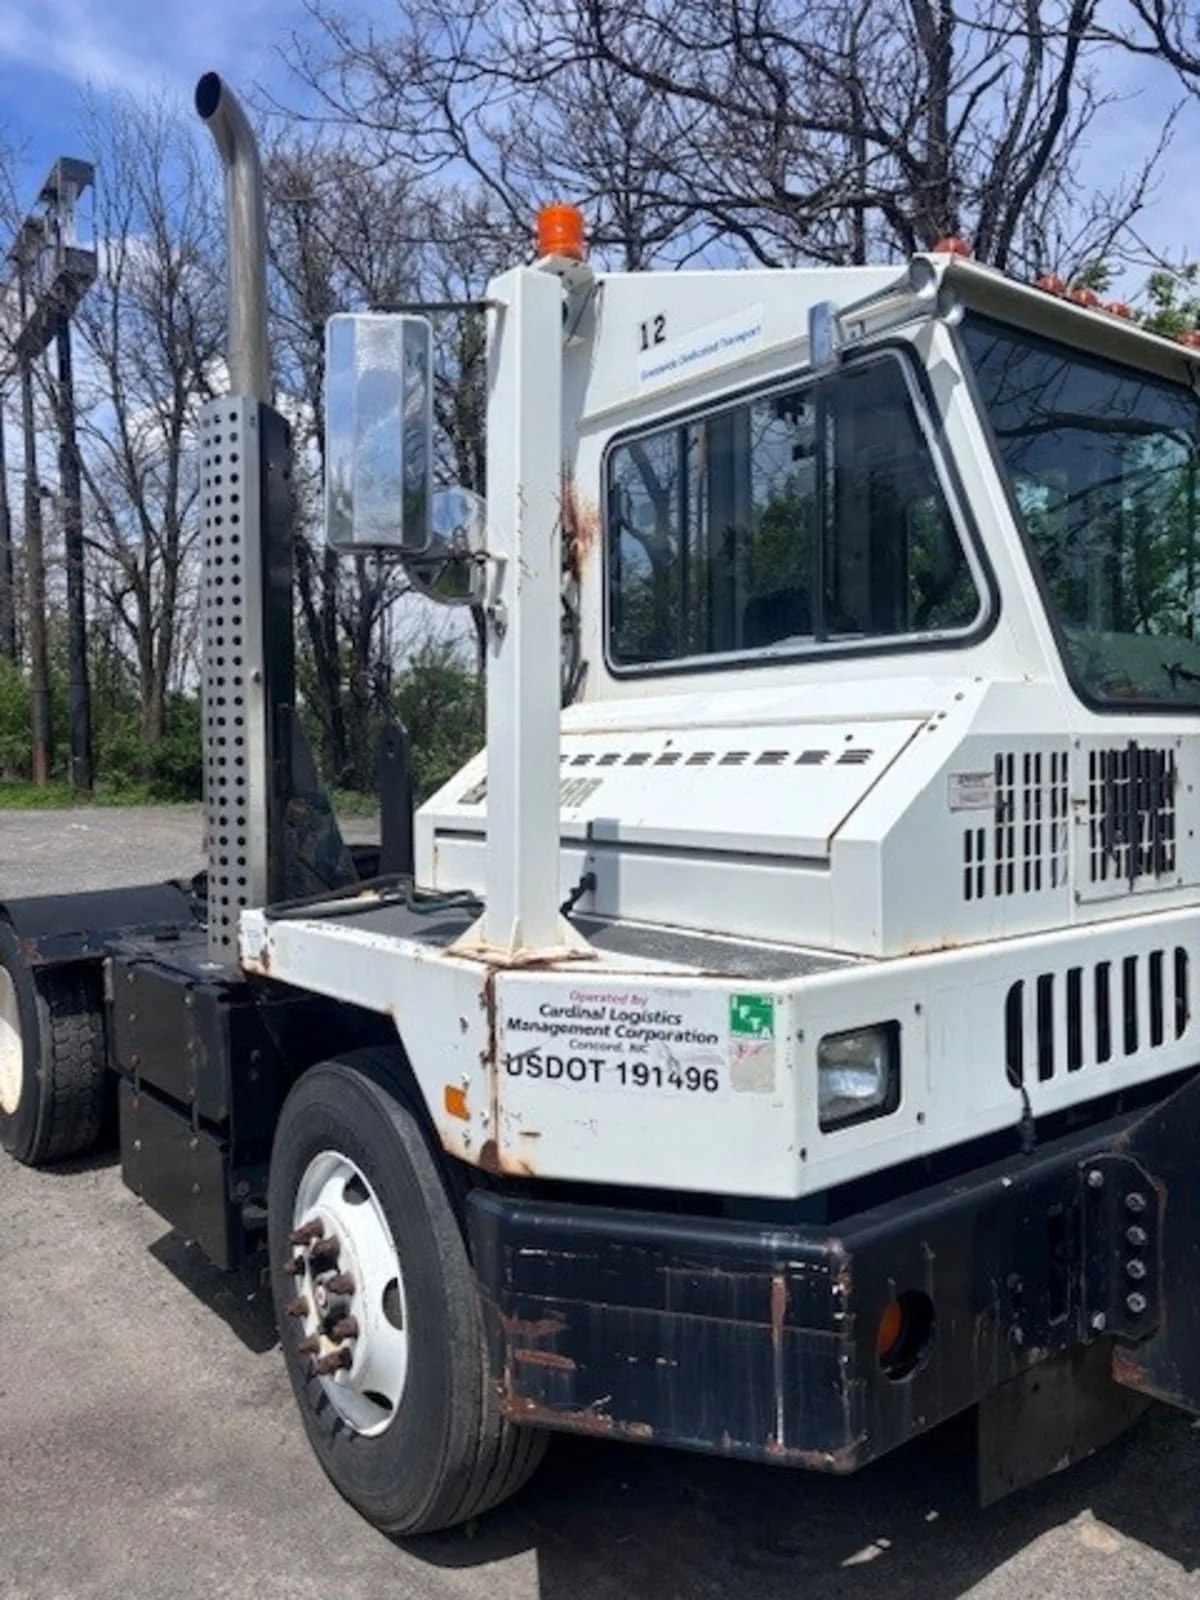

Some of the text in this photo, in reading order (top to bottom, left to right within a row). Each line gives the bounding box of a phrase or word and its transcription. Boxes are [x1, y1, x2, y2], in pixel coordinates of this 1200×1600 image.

[641, 313, 666, 351] 12
[569, 990, 648, 1008] Operated by
[538, 1003, 682, 1025] Cardinal Logistics
[506, 1018, 719, 1044] Management Corporation
[629, 1043, 649, 1054] NC
[505, 1052, 720, 1093] USDOT 191496
